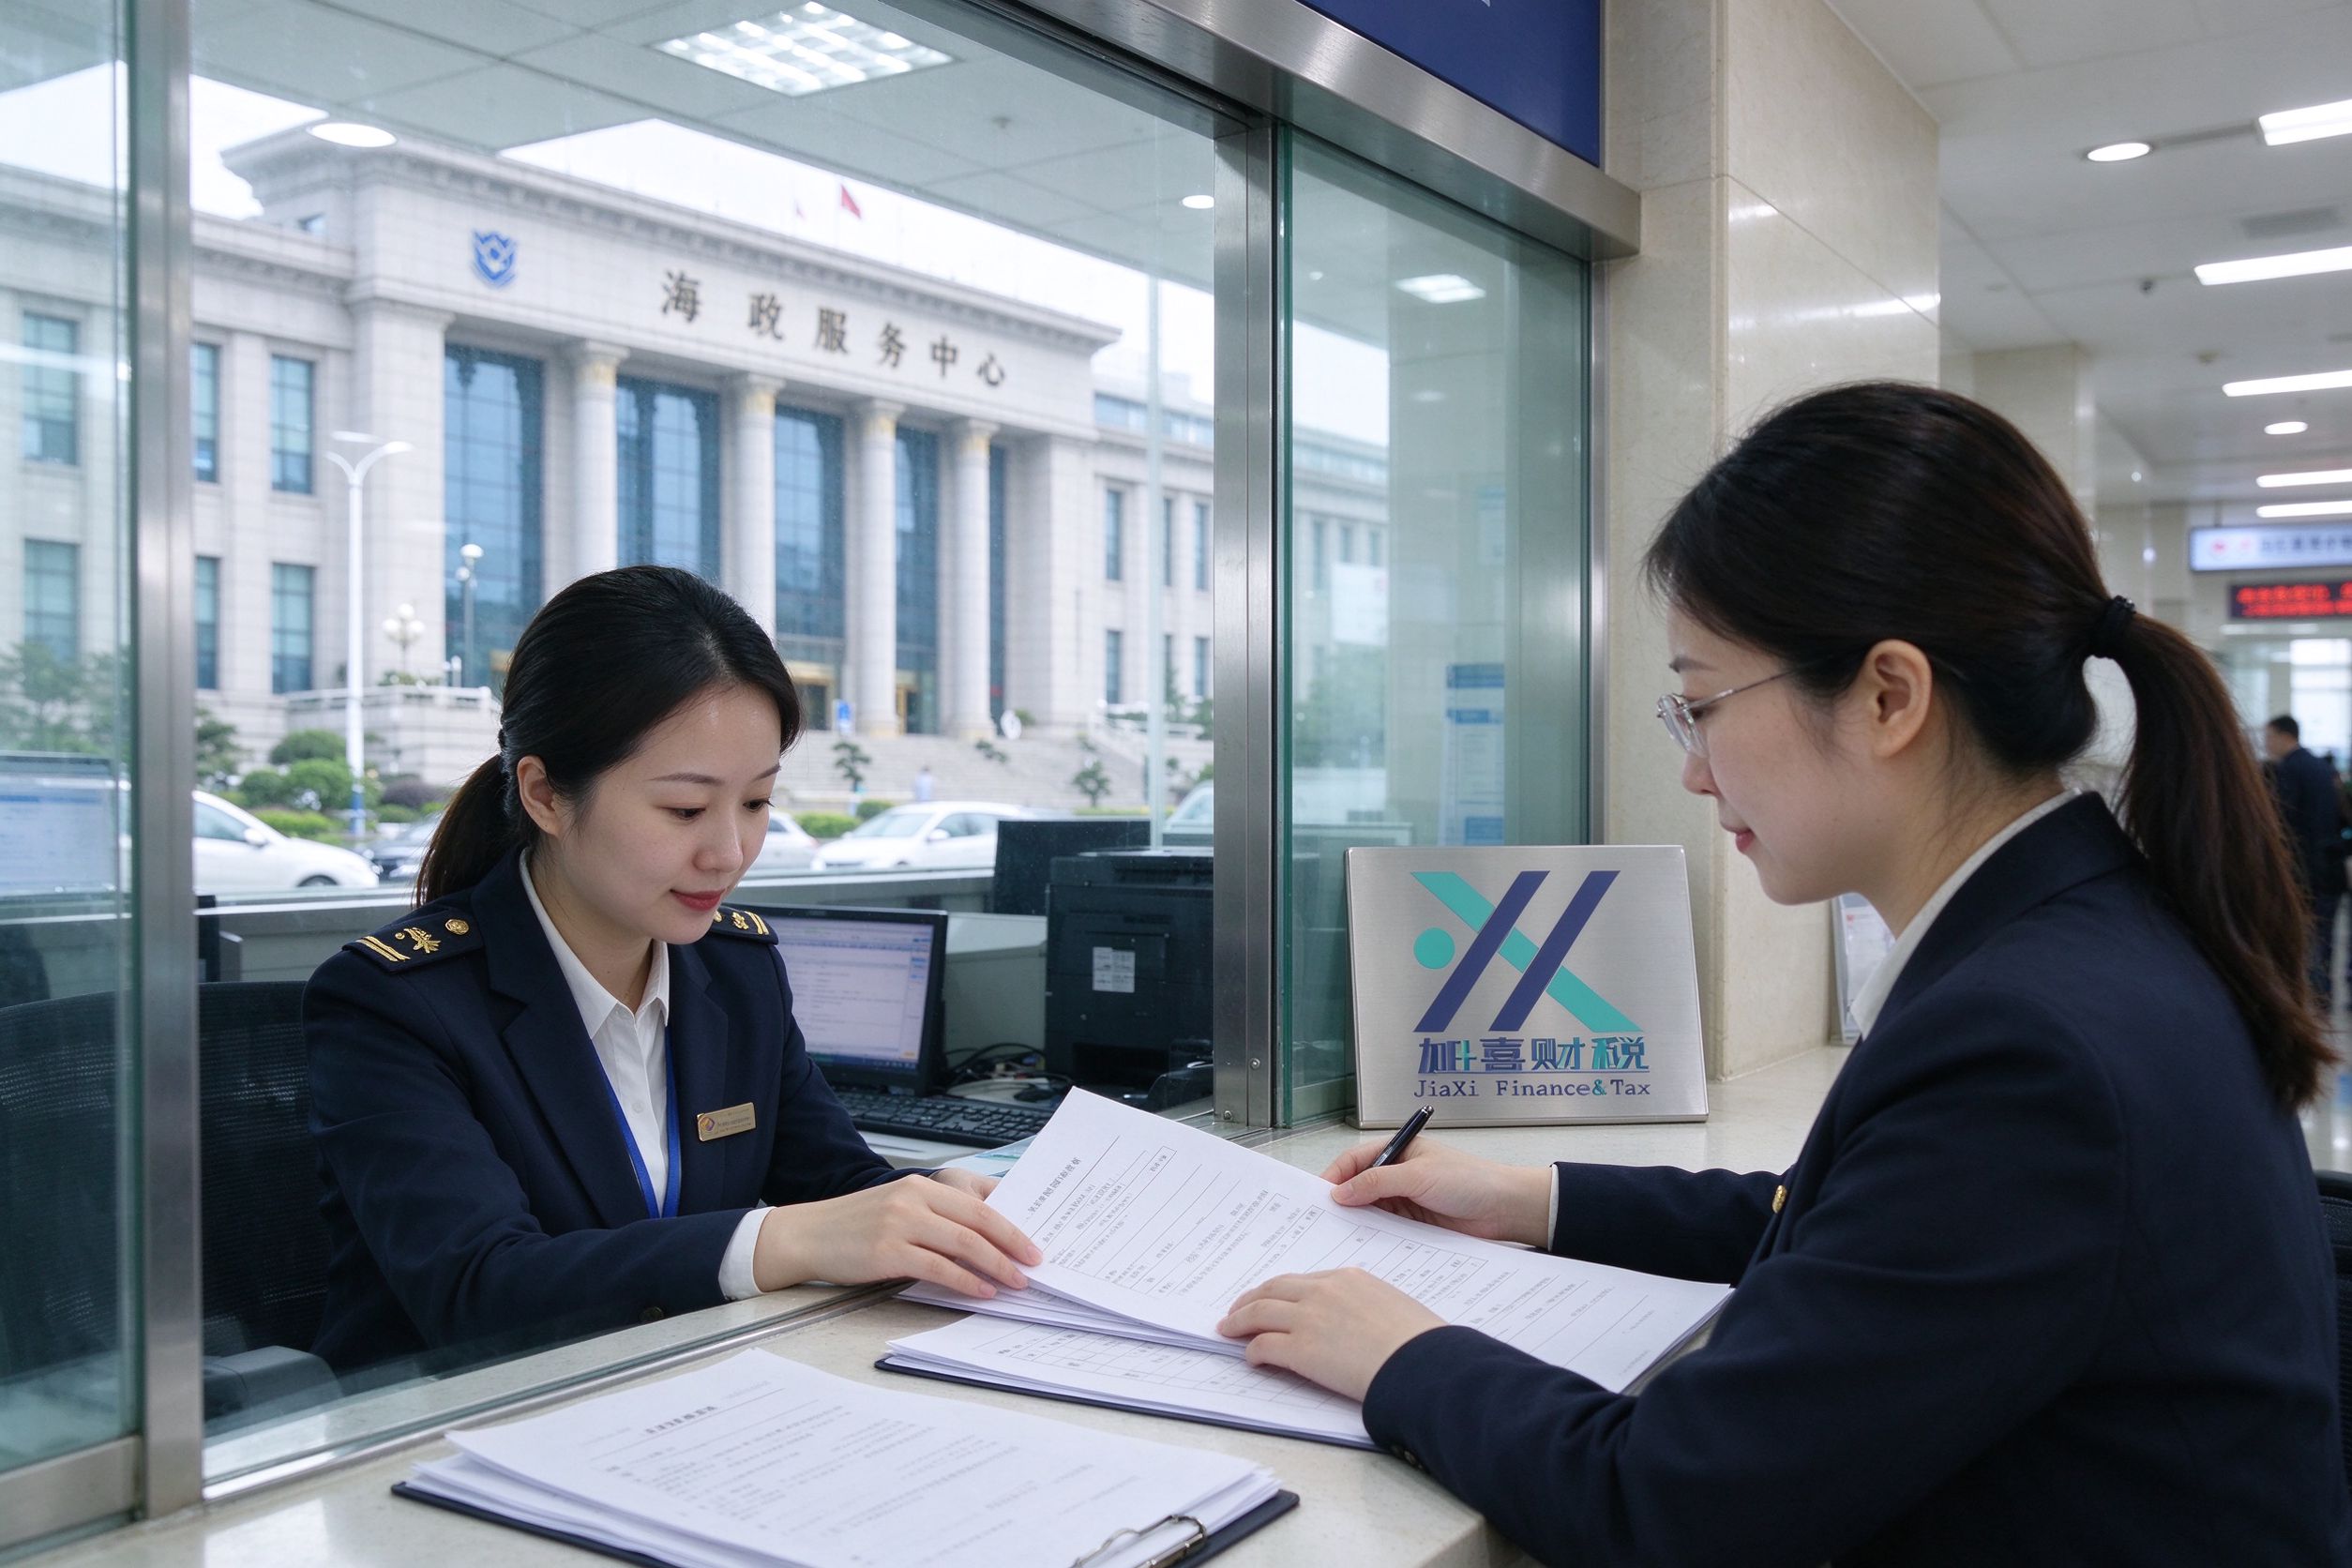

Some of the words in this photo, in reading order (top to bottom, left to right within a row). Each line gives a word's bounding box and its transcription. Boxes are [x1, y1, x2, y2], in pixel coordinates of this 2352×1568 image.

[661, 270, 1005, 387] 海政服务中心
[1414, 1079, 1480, 1097] JiaXi
